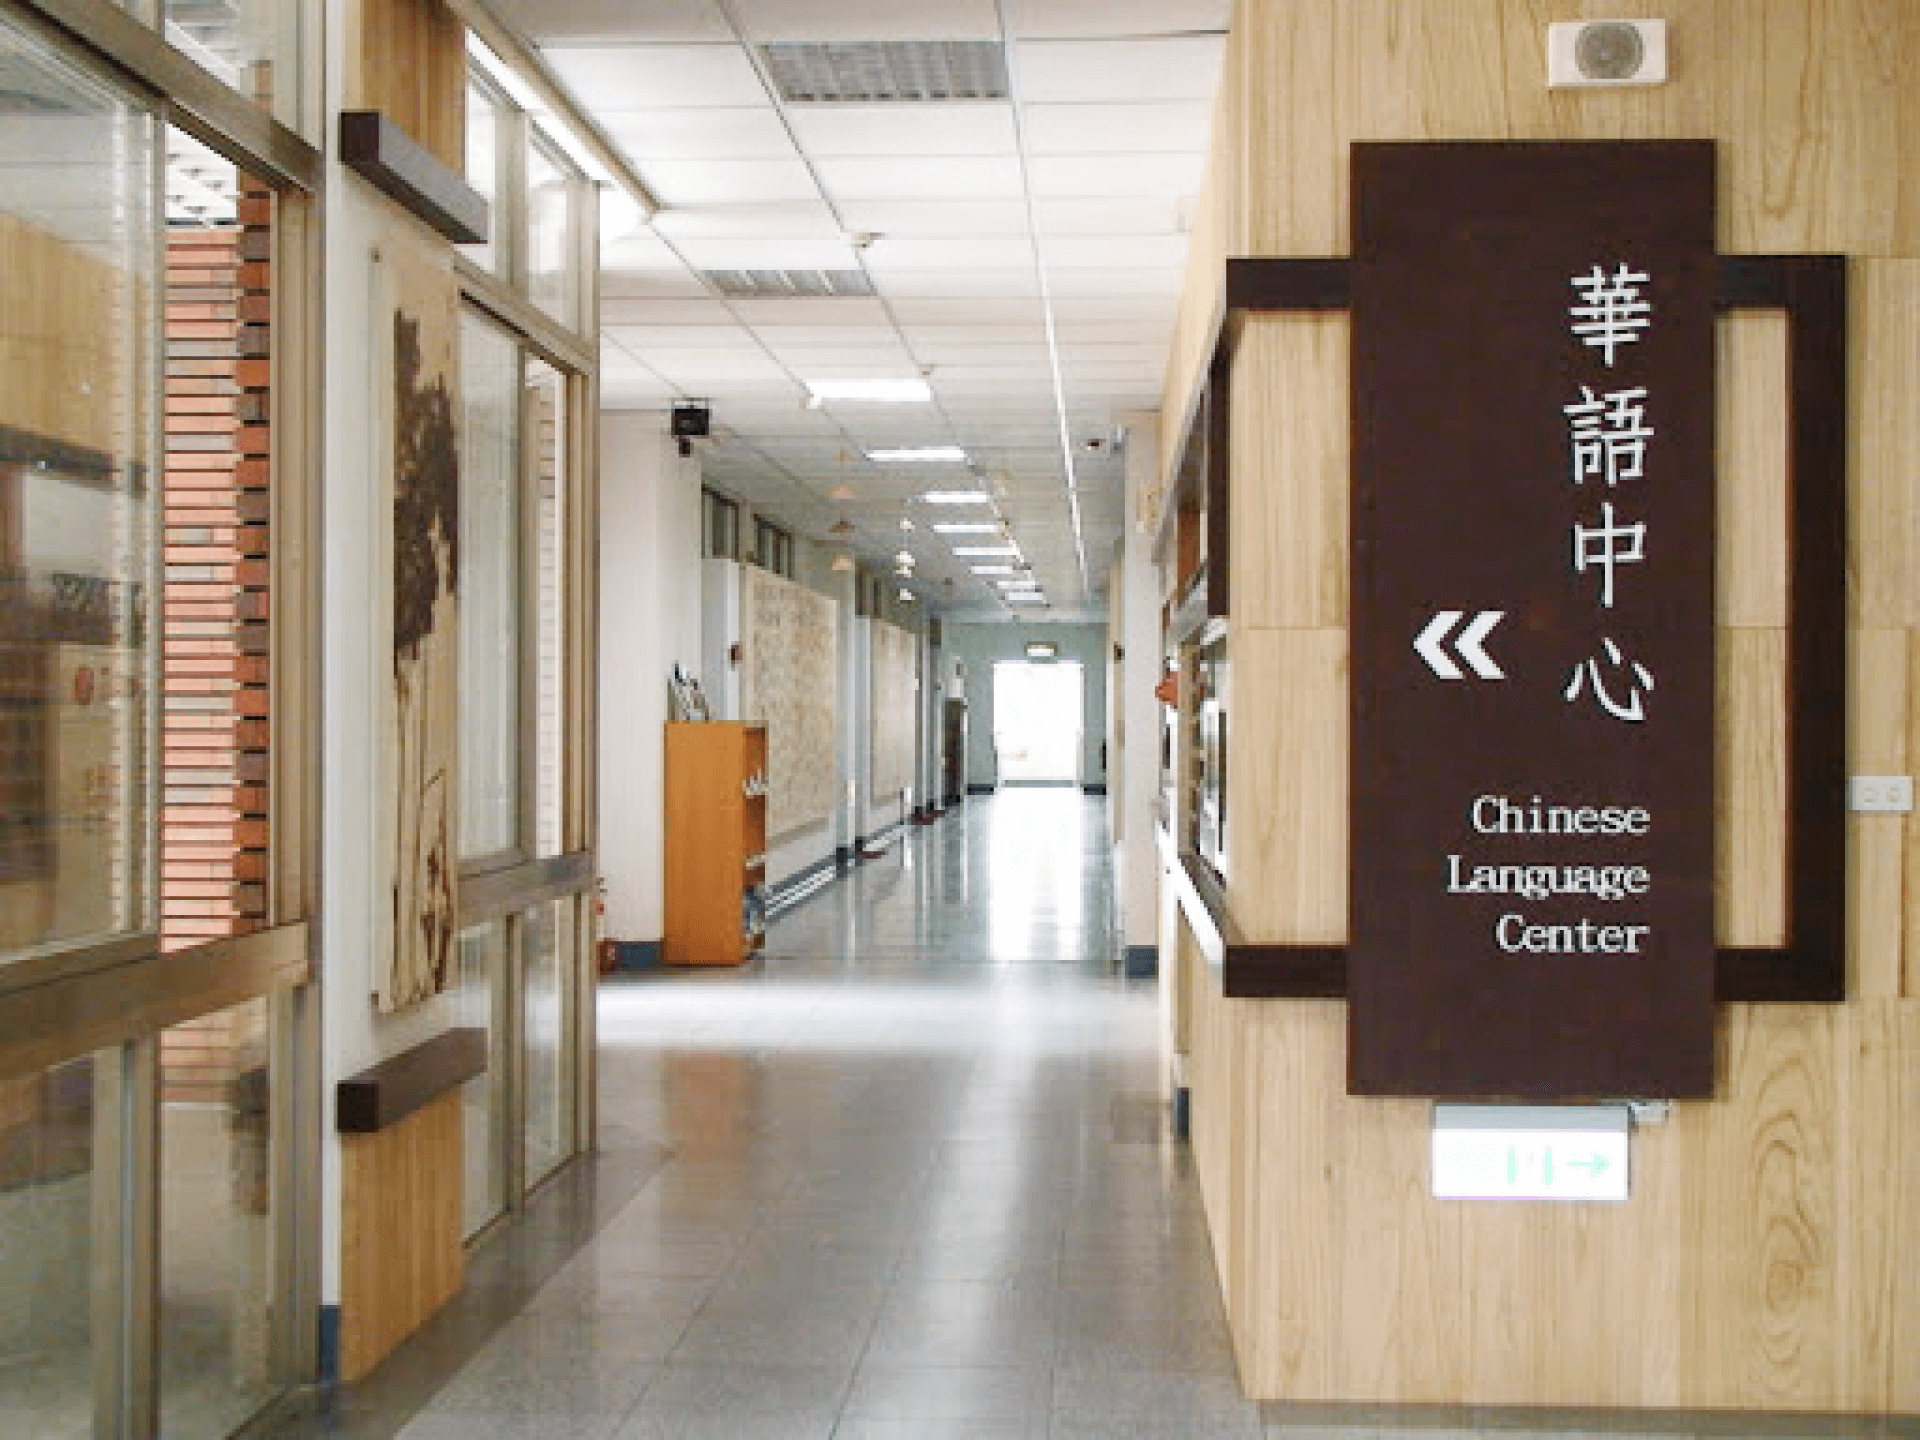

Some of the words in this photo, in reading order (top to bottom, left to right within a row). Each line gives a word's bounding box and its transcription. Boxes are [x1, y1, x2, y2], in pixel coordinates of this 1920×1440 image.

[1563, 262, 1655, 722] 華語中心
[1472, 794, 1651, 836] Chinese
[1447, 853, 1651, 901] Language
[1495, 913, 1651, 954] Center
